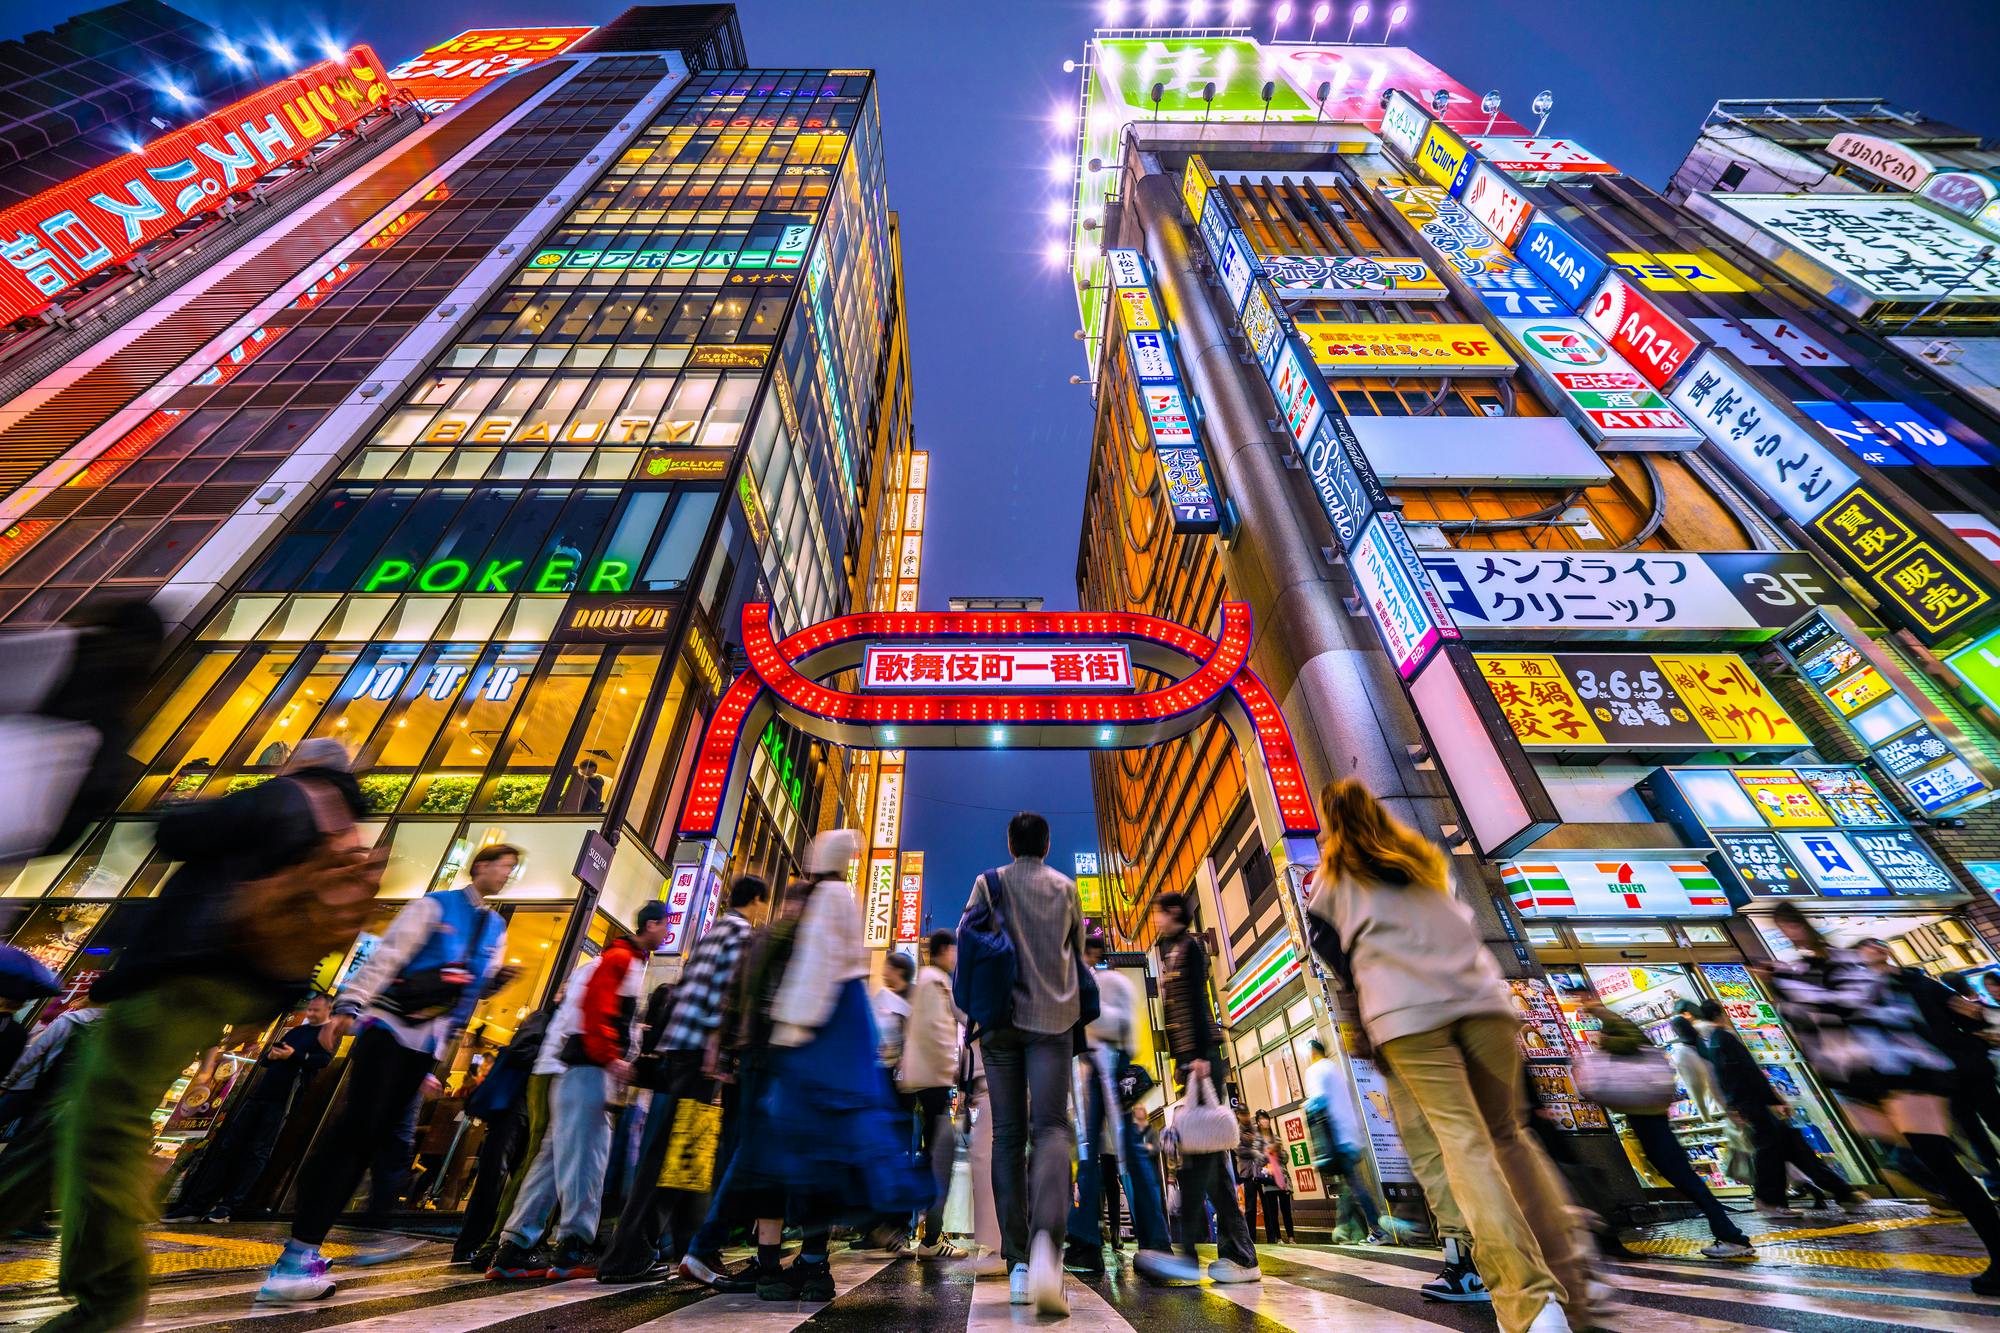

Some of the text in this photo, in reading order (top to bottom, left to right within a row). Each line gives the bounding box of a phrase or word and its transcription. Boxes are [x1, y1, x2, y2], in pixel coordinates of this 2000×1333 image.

[424, 36, 568, 53] パチンコ
[388, 54, 535, 80] エスパス
[709, 89, 836, 97] SHISHA
[707, 119, 824, 127] POKER
[1455, 162, 1470, 187] 6F
[785, 227, 808, 249] ダーツ
[1116, 252, 1138, 284] 小松ビル
[1530, 231, 1586, 290] セントラル
[1481, 291, 1558, 313] 7F
[1451, 341, 1490, 357] 6F
[1619, 311, 1672, 366] アコム
[1660, 349, 1682, 375] 3F
[1564, 374, 1641, 389] たばこ
[1597, 392, 1635, 407] 酒
[1602, 411, 1678, 428] ATM
[426, 420, 695, 443] BEAUTY
[1862, 452, 1886, 463] 4F
[1310, 439, 1356, 540] Sparkle
[1179, 506, 1211, 520] 7F
[1833, 503, 1899, 556] 買取
[364, 559, 629, 592] POKER
[1476, 556, 1825, 606] メンズライフ 3F
[1892, 557, 1969, 620] 販売
[570, 608, 669, 628] DOUTOR
[1492, 592, 1677, 623] クリニック
[1410, 644, 1426, 665] B2F
[874, 652, 1120, 683] 歌舞伎町一番街
[1488, 660, 1541, 676] 名物
[1689, 662, 1763, 697] ビール
[1489, 680, 1574, 707] 鉄鍋
[1675, 672, 1722, 721] 格安
[1509, 708, 1588, 739] 餃子
[1611, 700, 1672, 727] 酒場
[1725, 704, 1792, 740] サワー
[1916, 727, 1928, 737] 4F
[1885, 744, 1920, 764] STAND
[1855, 833, 1913, 850] BUZZ 4F
[1866, 850, 1926, 866] STAND
[1768, 884, 1790, 893] 2F
[663, 873, 693, 945] 劇場通り
[876, 865, 892, 940] KKLIVE
[901, 892, 919, 937] 安楽亭
[1723, 1004, 1757, 1018] たばこ
[1757, 1004, 1777, 1018] 酒
[1298, 1169, 1317, 1191] ATM
